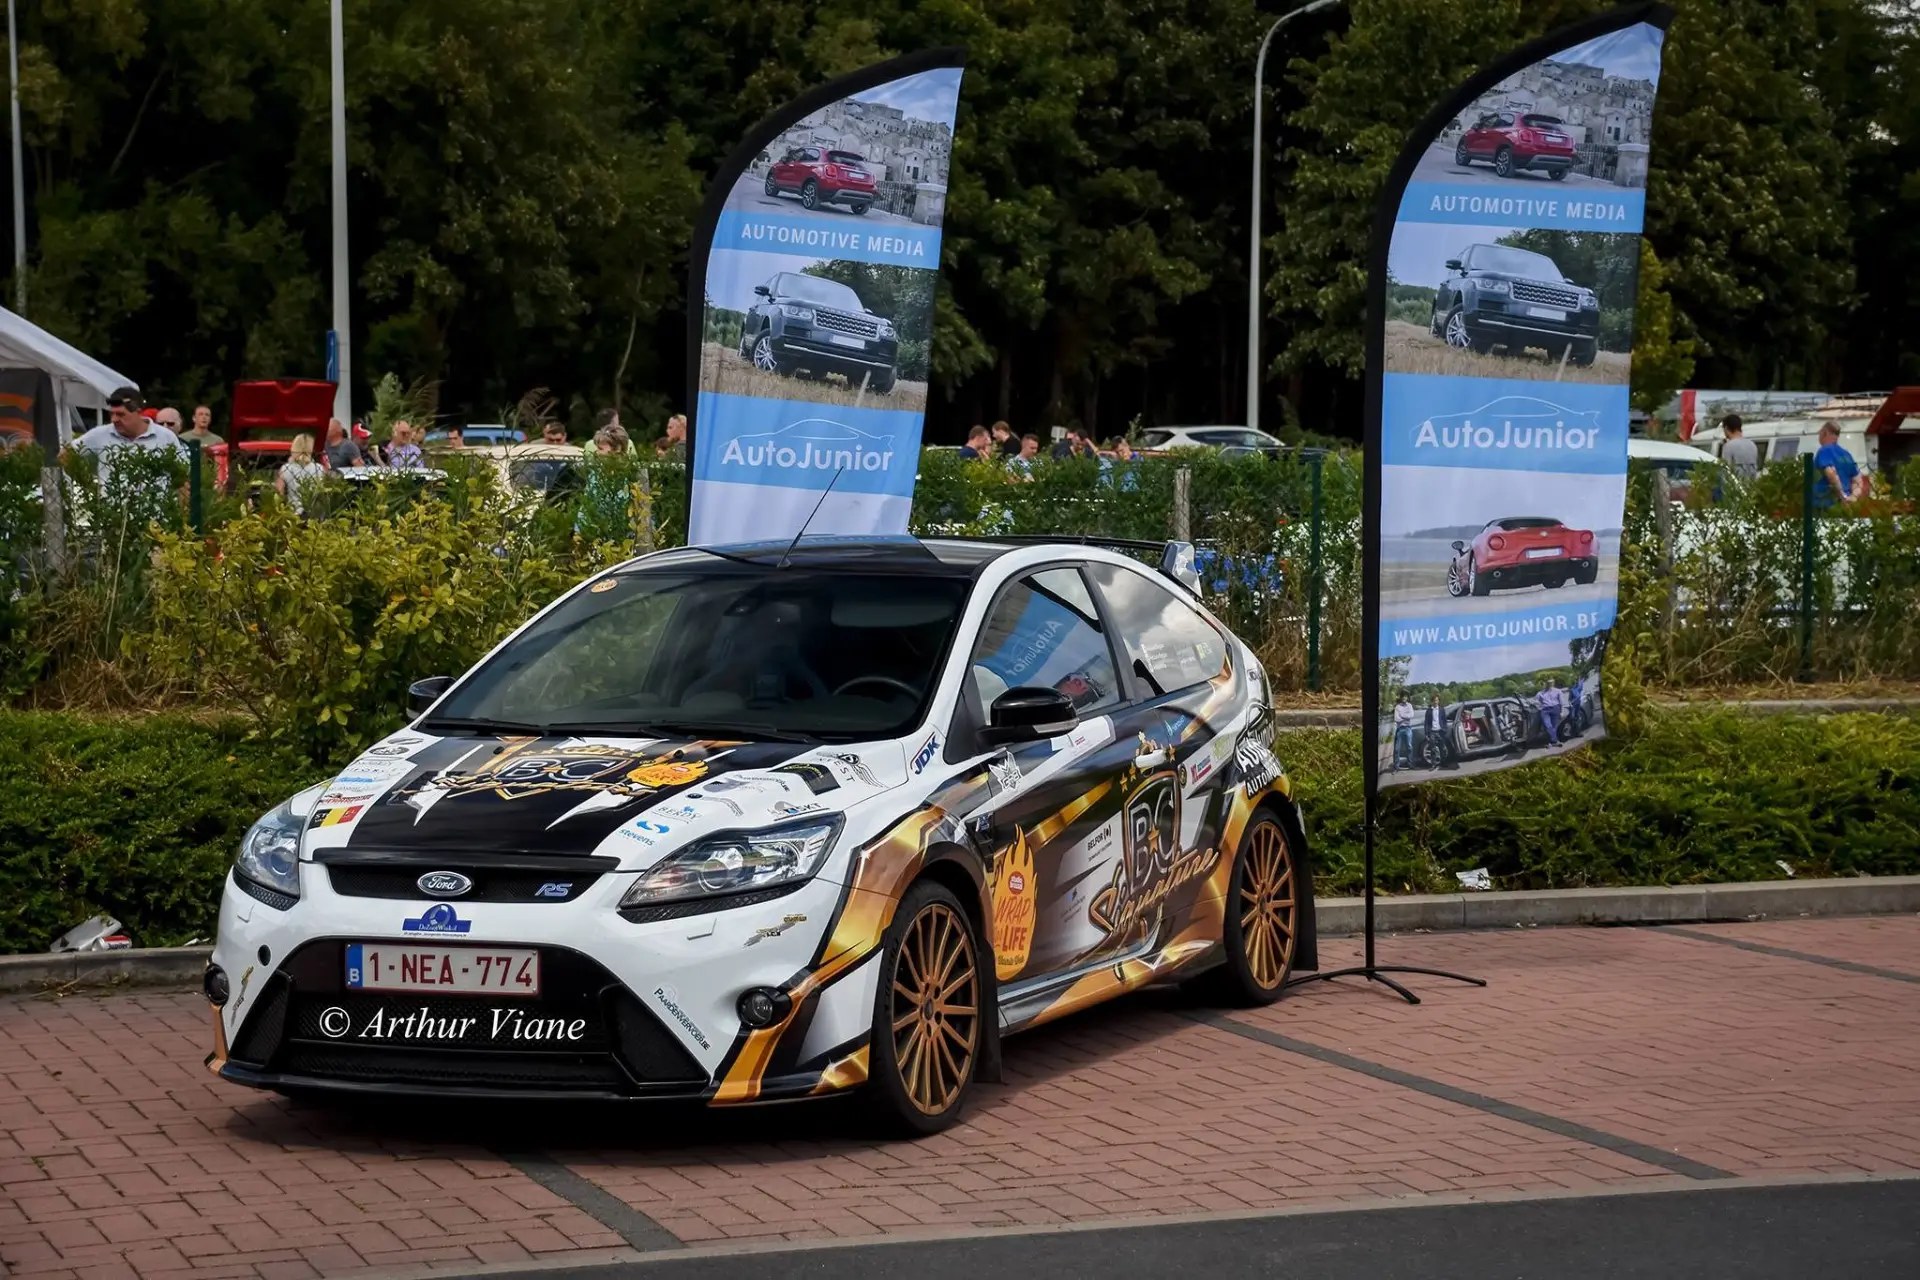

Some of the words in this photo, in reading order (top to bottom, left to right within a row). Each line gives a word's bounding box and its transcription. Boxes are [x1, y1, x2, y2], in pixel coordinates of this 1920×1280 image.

[1430, 194, 1558, 218] AUTOMOTIVE
[1566, 197, 1626, 221] MEDIA
[741, 223, 859, 250] AUTOMOTIVE
[867, 234, 924, 257] MEDIA
[1415, 420, 1599, 451] AutoJunior
[721, 438, 894, 472] AutoJunior
[914, 734, 941, 775] JDK
[493, 758, 616, 782] BC
[618, 827, 656, 846] stevens
[1130, 786, 1176, 892] BC
[427, 875, 456, 890] Ford
[534, 883, 572, 896] RS
[995, 896, 1031, 925] WRAP
[1002, 926, 1027, 952] LIFE
[349, 968, 360, 982] B
[369, 952, 532, 987] 1-NEA-774
